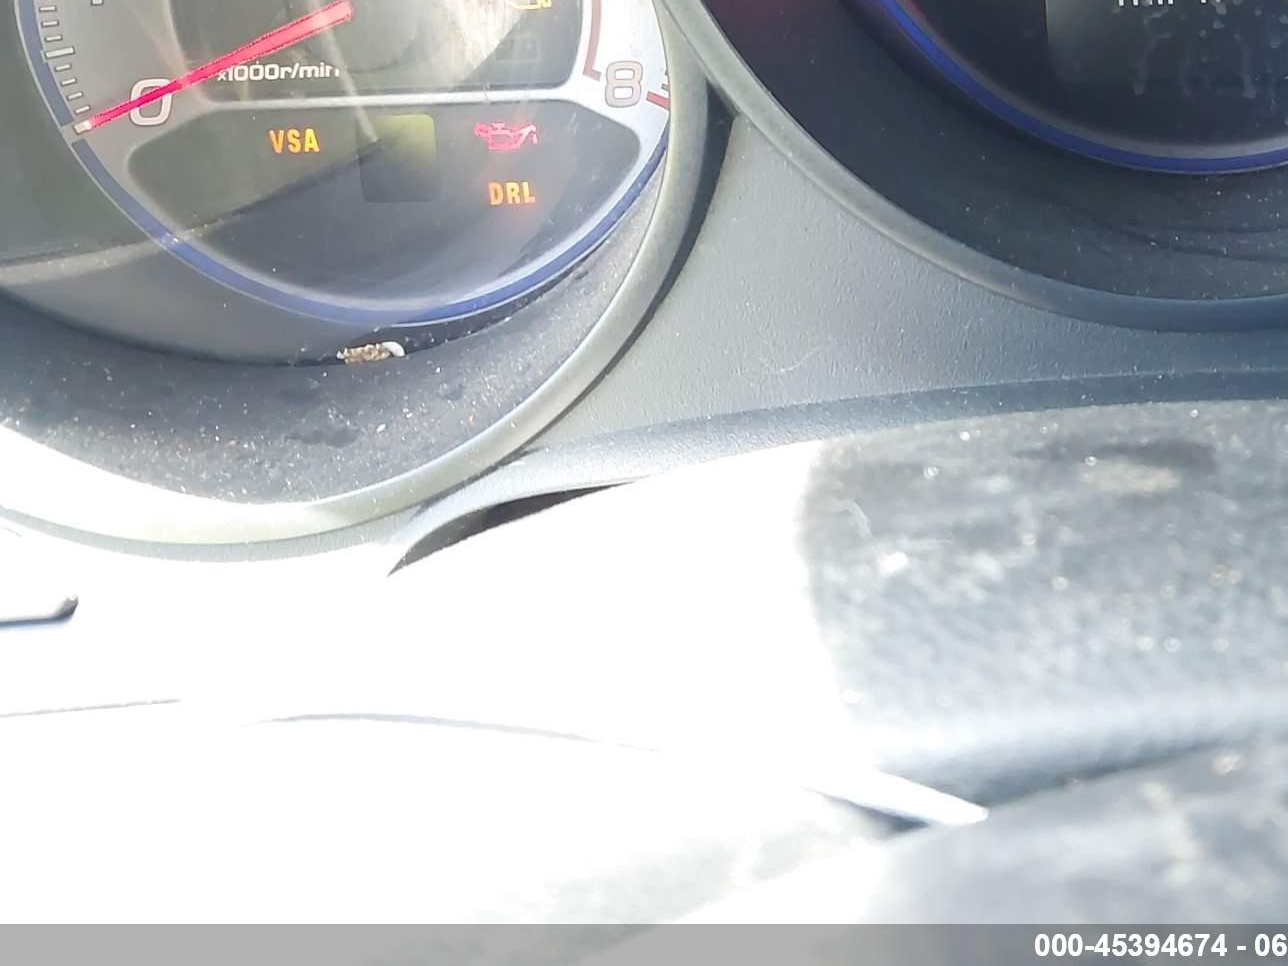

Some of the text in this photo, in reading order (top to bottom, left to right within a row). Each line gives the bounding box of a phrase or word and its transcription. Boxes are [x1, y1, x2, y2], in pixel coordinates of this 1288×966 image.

[129, 78, 173, 126] 0
[604, 60, 643, 108] 8
[269, 128, 320, 154] VSA
[488, 181, 536, 206] DRL
